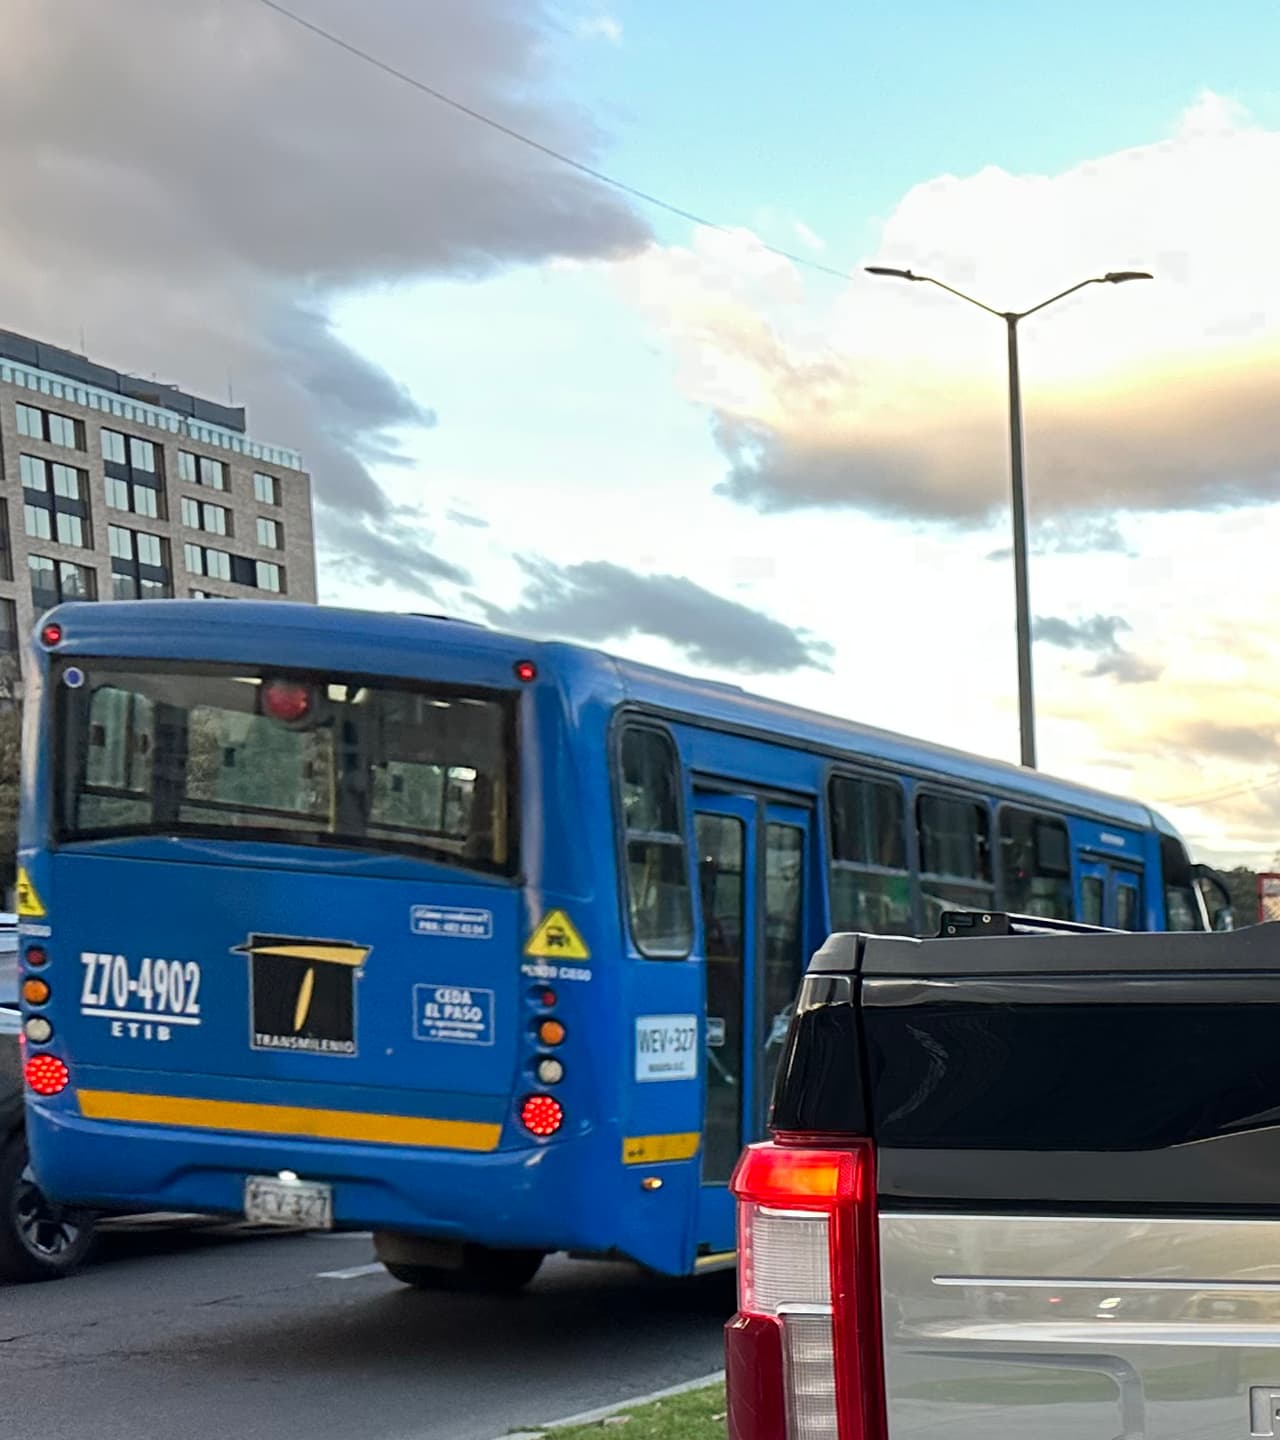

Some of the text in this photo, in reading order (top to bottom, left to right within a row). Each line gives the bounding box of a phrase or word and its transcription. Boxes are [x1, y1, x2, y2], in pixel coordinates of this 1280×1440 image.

[80, 952, 201, 1015] Z70-4902
[434, 988, 473, 1005] CEDA
[424, 1003, 483, 1022] EL PASO
[111, 1021, 172, 1041] ETIB
[255, 1032, 356, 1054] TRANSMILENIO
